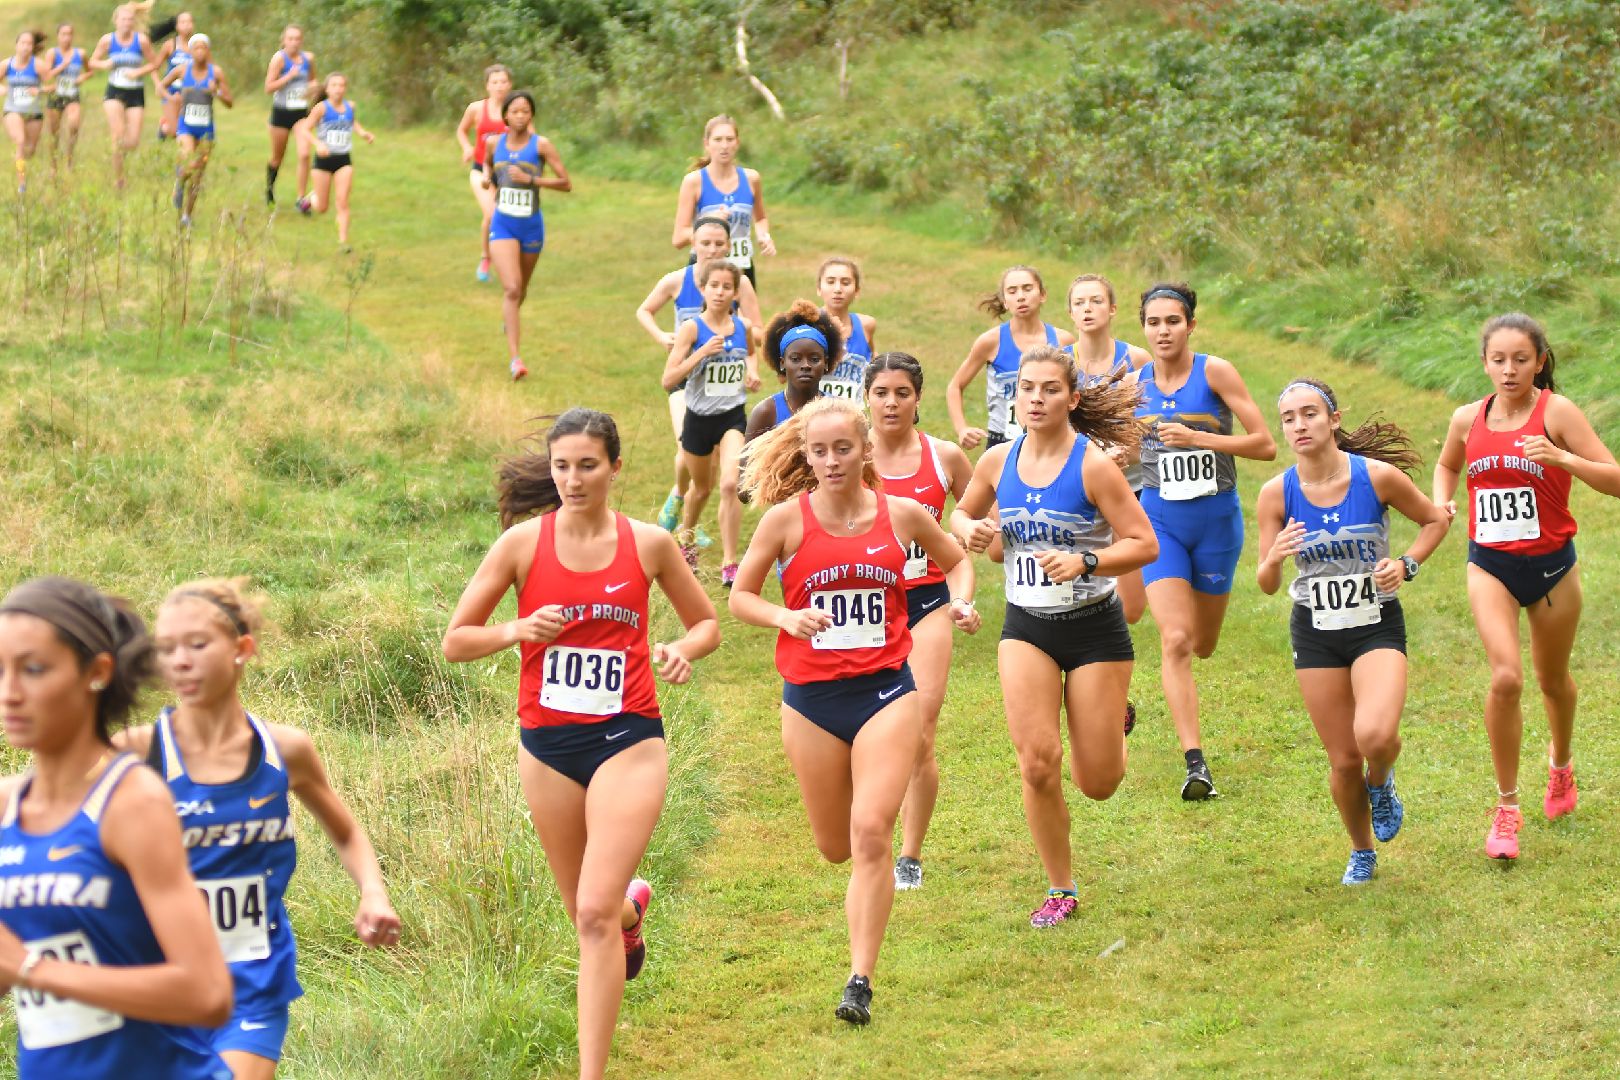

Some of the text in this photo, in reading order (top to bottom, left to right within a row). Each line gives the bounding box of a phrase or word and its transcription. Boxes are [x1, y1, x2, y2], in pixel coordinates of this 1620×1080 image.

[501, 190, 531, 206] 1011
[725, 239, 749, 258] 16
[707, 364, 744, 384] 1023
[1162, 453, 1214, 483] 1008
[1467, 455, 1544, 480] STONY BROOK
[1479, 490, 1535, 522] 1033
[1002, 520, 1075, 547] PIRATES
[855, 563, 898, 587] BROOK
[1016, 555, 1063, 587] 101
[1311, 577, 1376, 611] 1024
[592, 603, 640, 630] BROOK
[546, 650, 622, 692] 1036
[198, 883, 263, 932] 04
